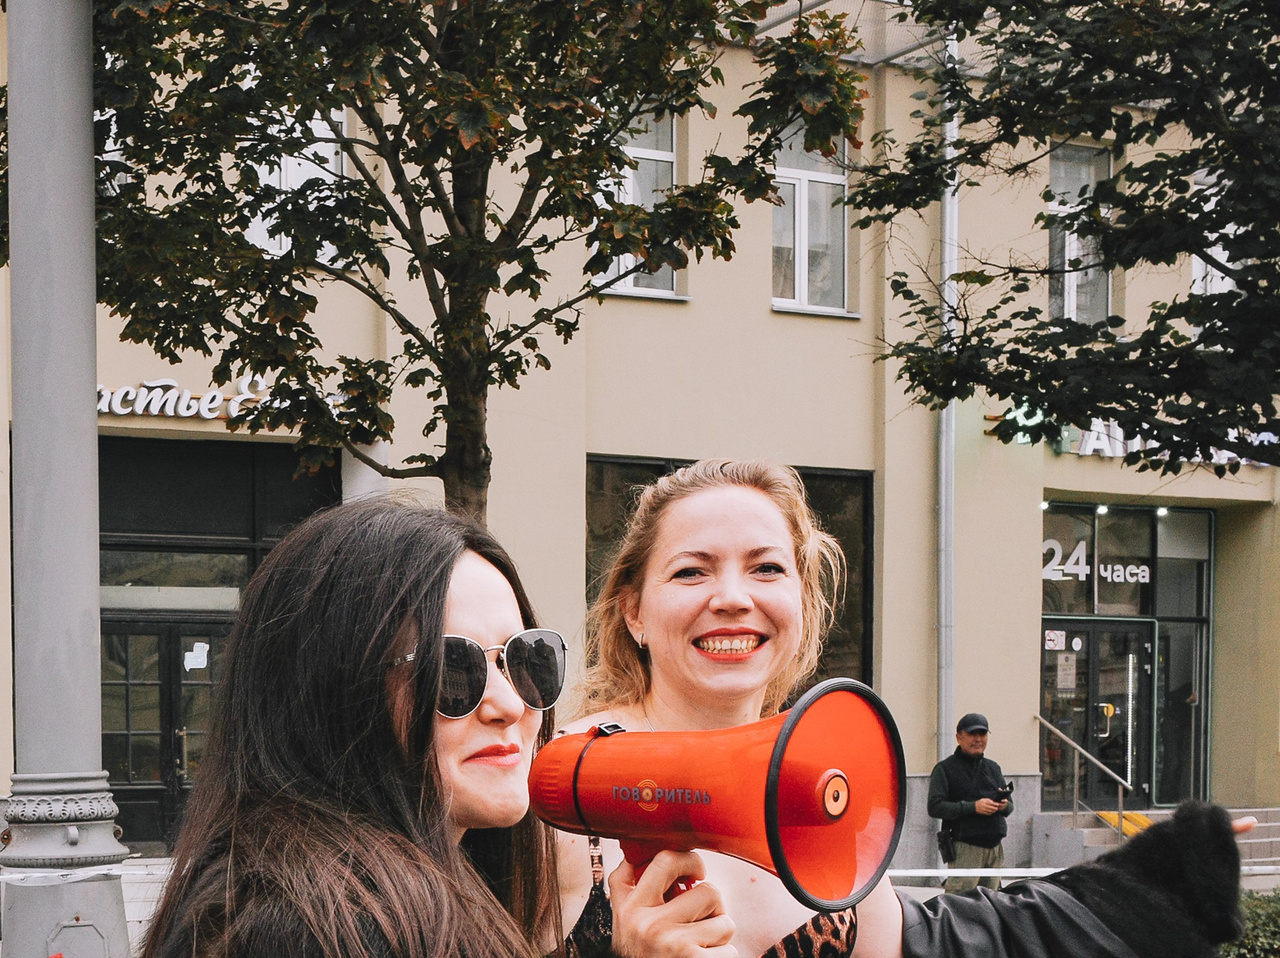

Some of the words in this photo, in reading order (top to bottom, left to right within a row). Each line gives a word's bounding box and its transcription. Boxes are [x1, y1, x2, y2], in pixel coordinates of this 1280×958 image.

[1041, 539, 1090, 581] 24
[1099, 563, 1150, 583] часа
[612, 785, 711, 805] ГОВОРИТЕЛЬ
